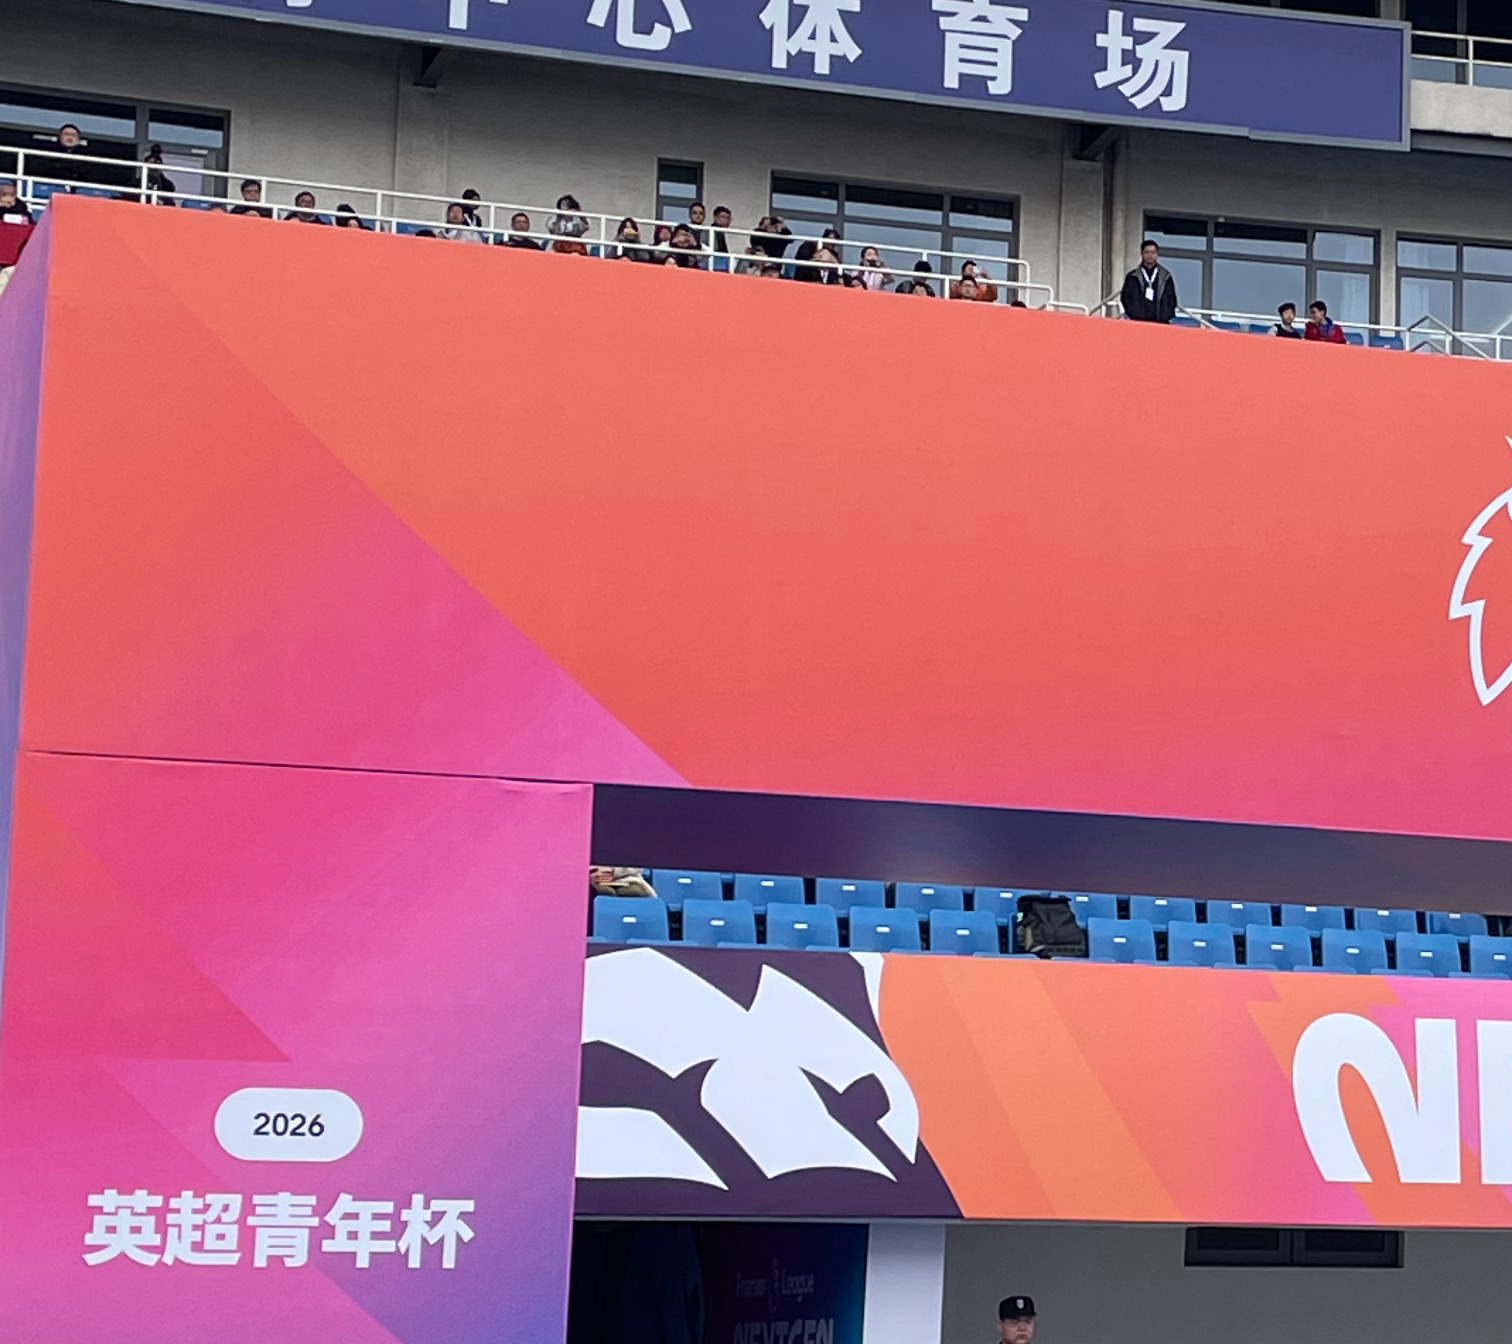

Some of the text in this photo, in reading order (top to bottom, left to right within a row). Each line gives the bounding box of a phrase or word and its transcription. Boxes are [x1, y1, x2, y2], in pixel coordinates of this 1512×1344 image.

[253, 1112, 325, 1137] 2026
[82, 1189, 475, 1269] 英超青年杯
